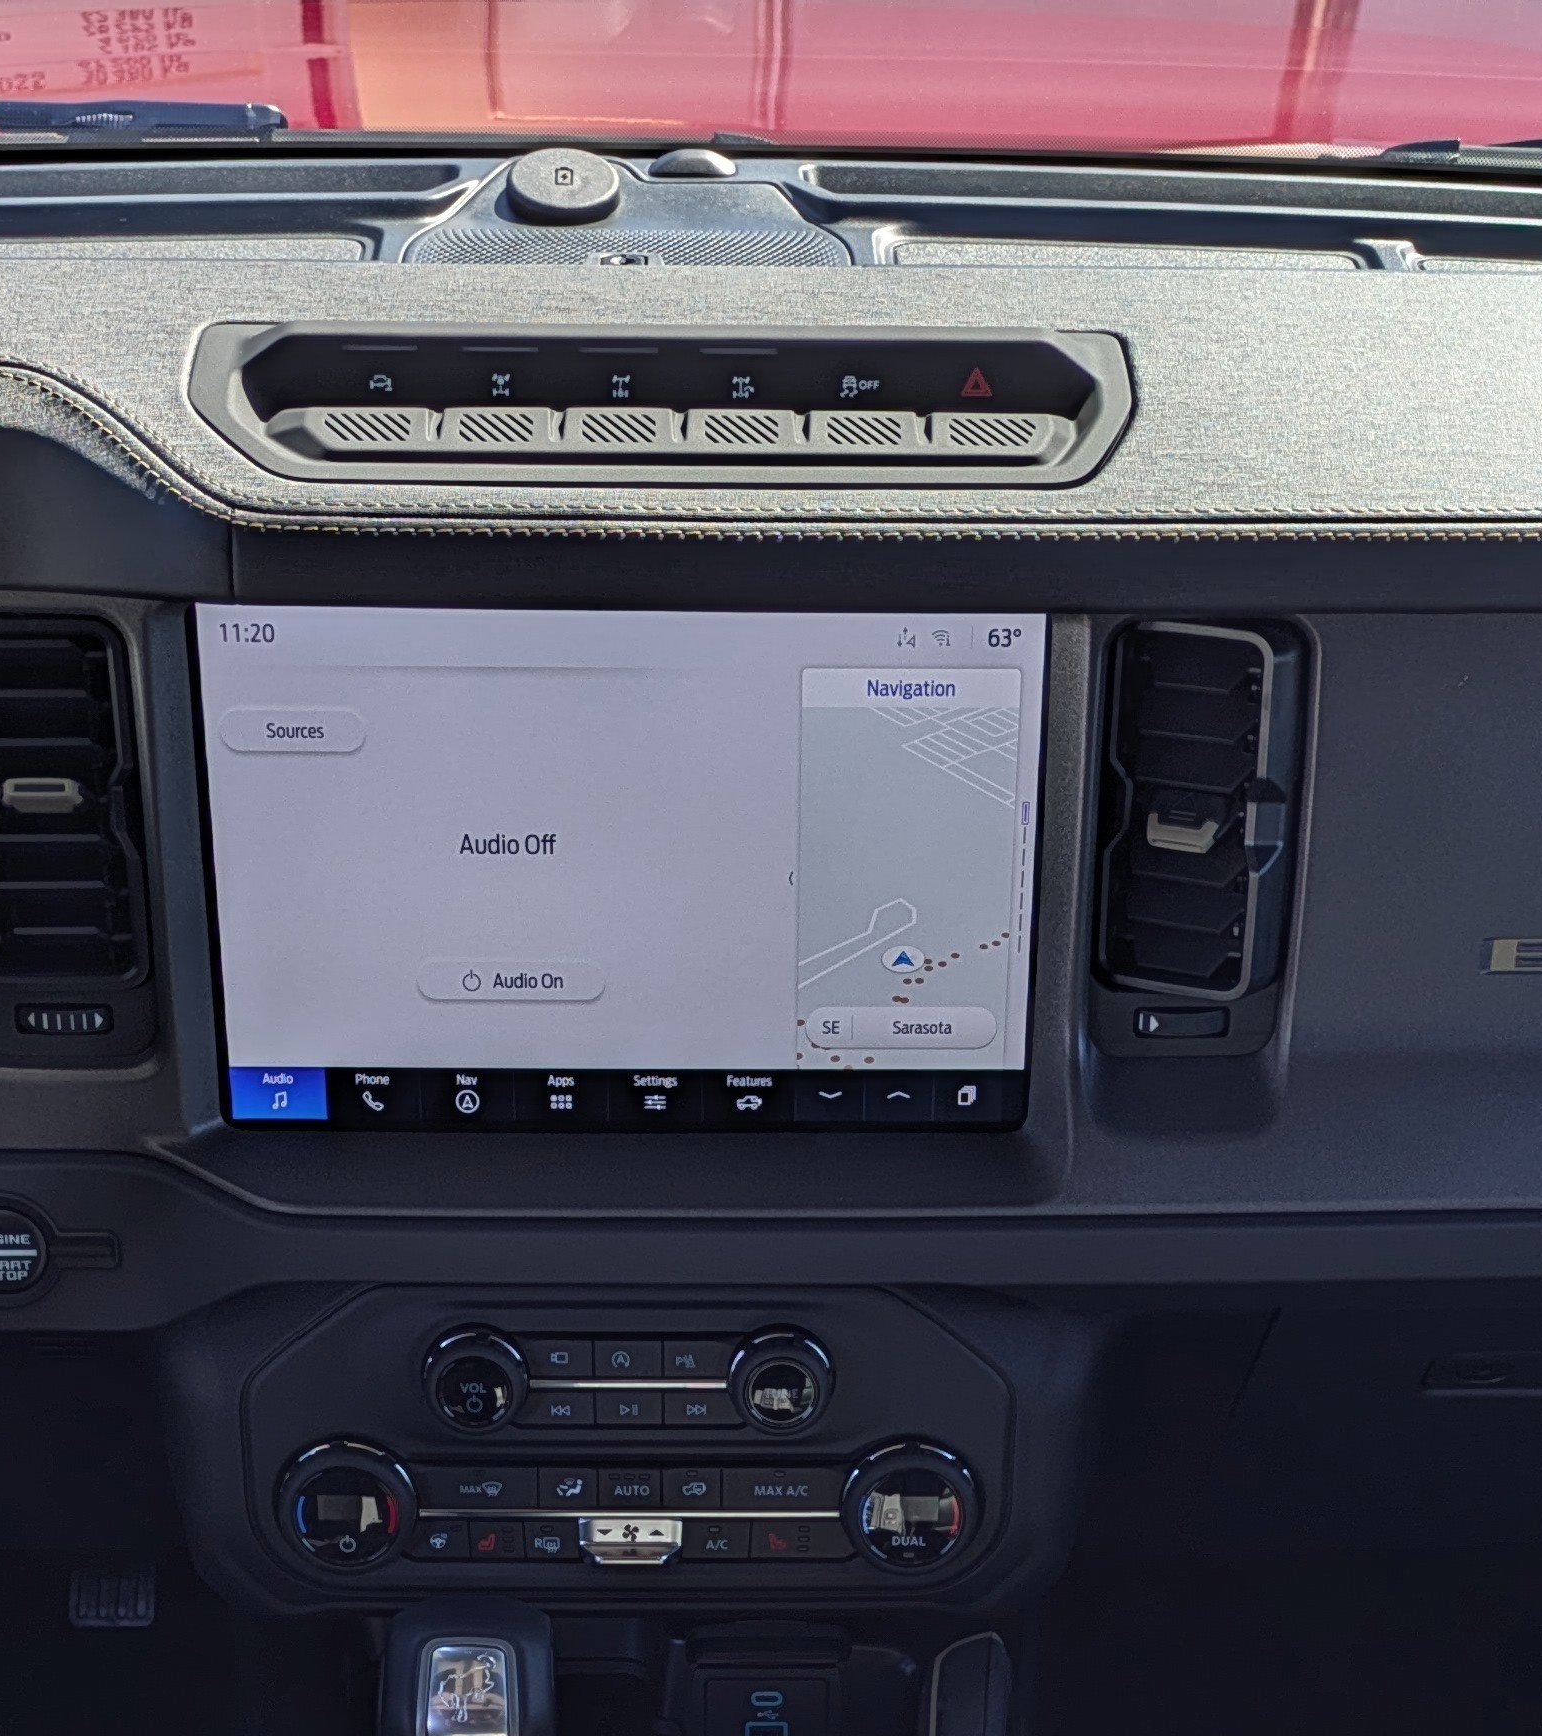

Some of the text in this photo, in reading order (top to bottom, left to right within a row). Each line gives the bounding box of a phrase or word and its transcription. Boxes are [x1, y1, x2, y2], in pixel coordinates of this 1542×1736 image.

[858, 379, 880, 391] OFF
[219, 623, 275, 643] 11:20
[987, 628, 1022, 648] 63°
[866, 679, 956, 700] Navigation
[265, 722, 325, 740] Sources
[459, 833, 557, 856] Audio Off
[492, 973, 564, 990] Audio On
[822, 1020, 953, 1036] SE Sarasota
[262, 1072, 294, 1086] Audio
[354, 1073, 390, 1086] Phone
[455, 1074, 478, 1086] Nav
[547, 1074, 575, 1088] Apps
[633, 1075, 678, 1089] Settings
[726, 1075, 773, 1088] Features
[460, 1382, 487, 1394] VOL
[613, 1485, 650, 1497] AUTO
[753, 1484, 809, 1497] MAX A/C
[705, 1538, 728, 1550] A/C
[891, 1535, 927, 1548] DUAL
